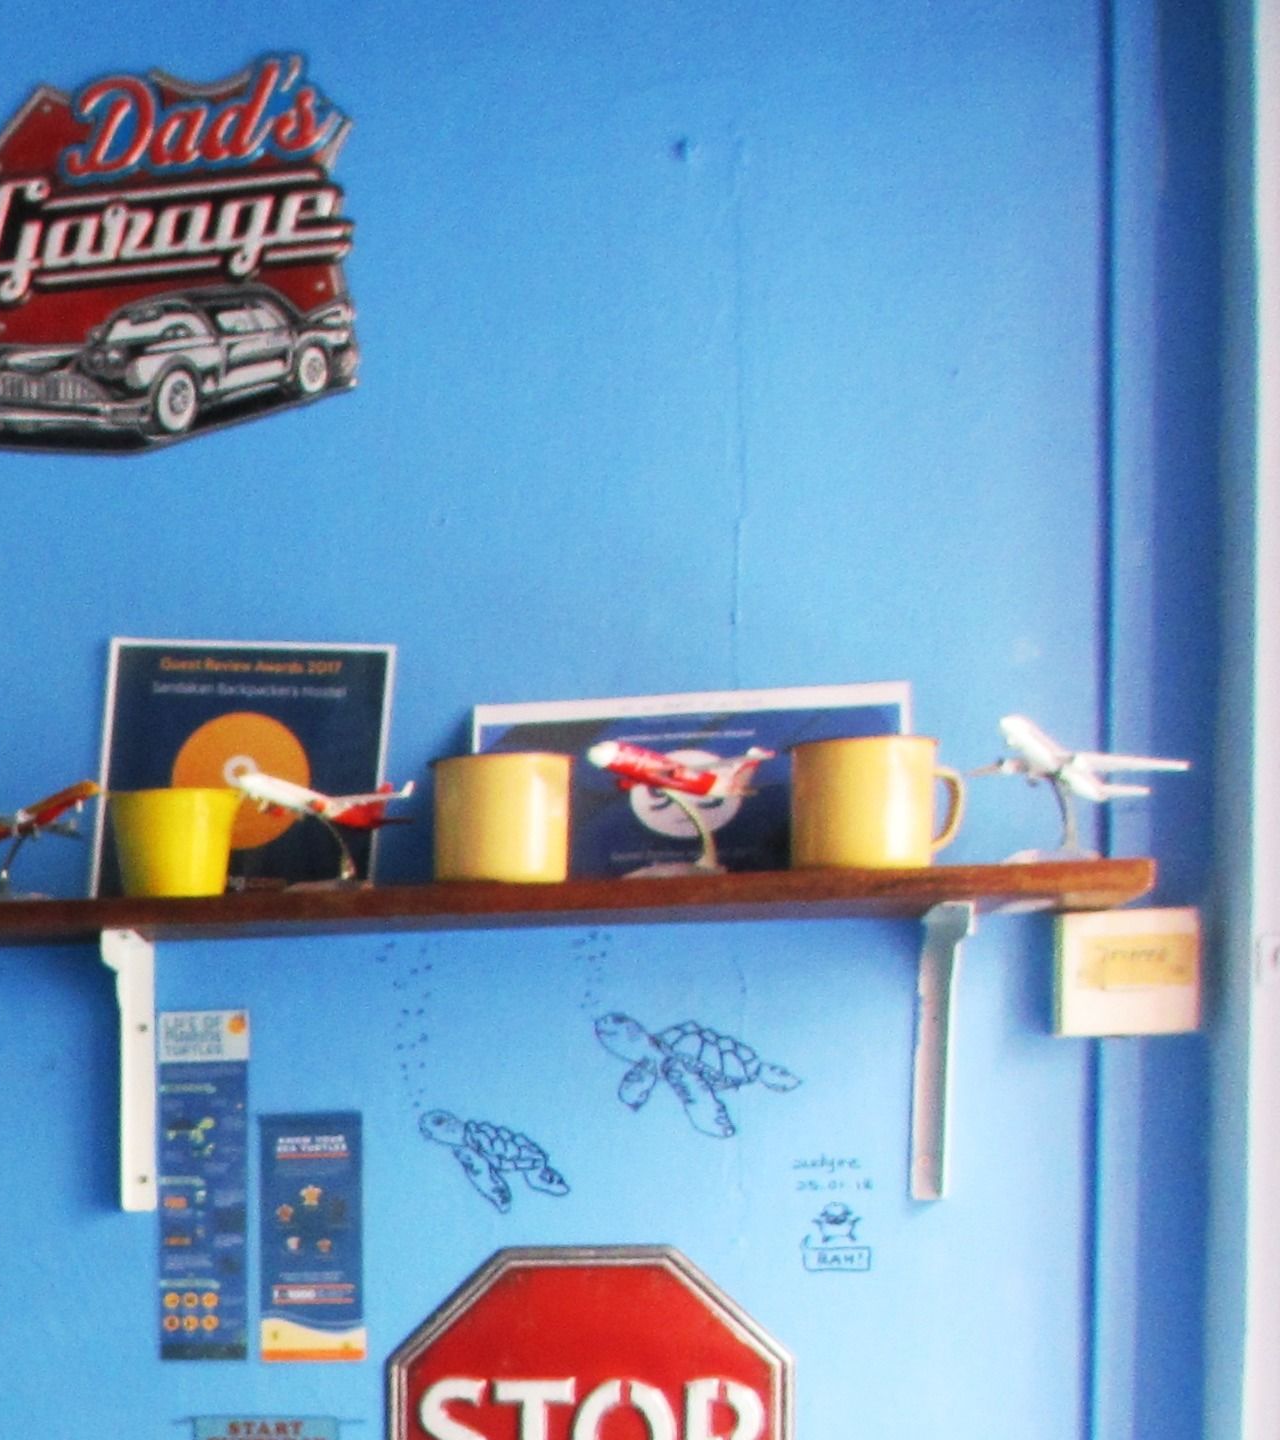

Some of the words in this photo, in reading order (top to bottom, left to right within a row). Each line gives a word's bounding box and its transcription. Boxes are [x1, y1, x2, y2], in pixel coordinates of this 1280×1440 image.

[66, 56, 337, 176] Dad's
[255, 660, 303, 675] Awards
[307, 660, 342, 674] 2017
[228, 1421, 303, 1435] START
